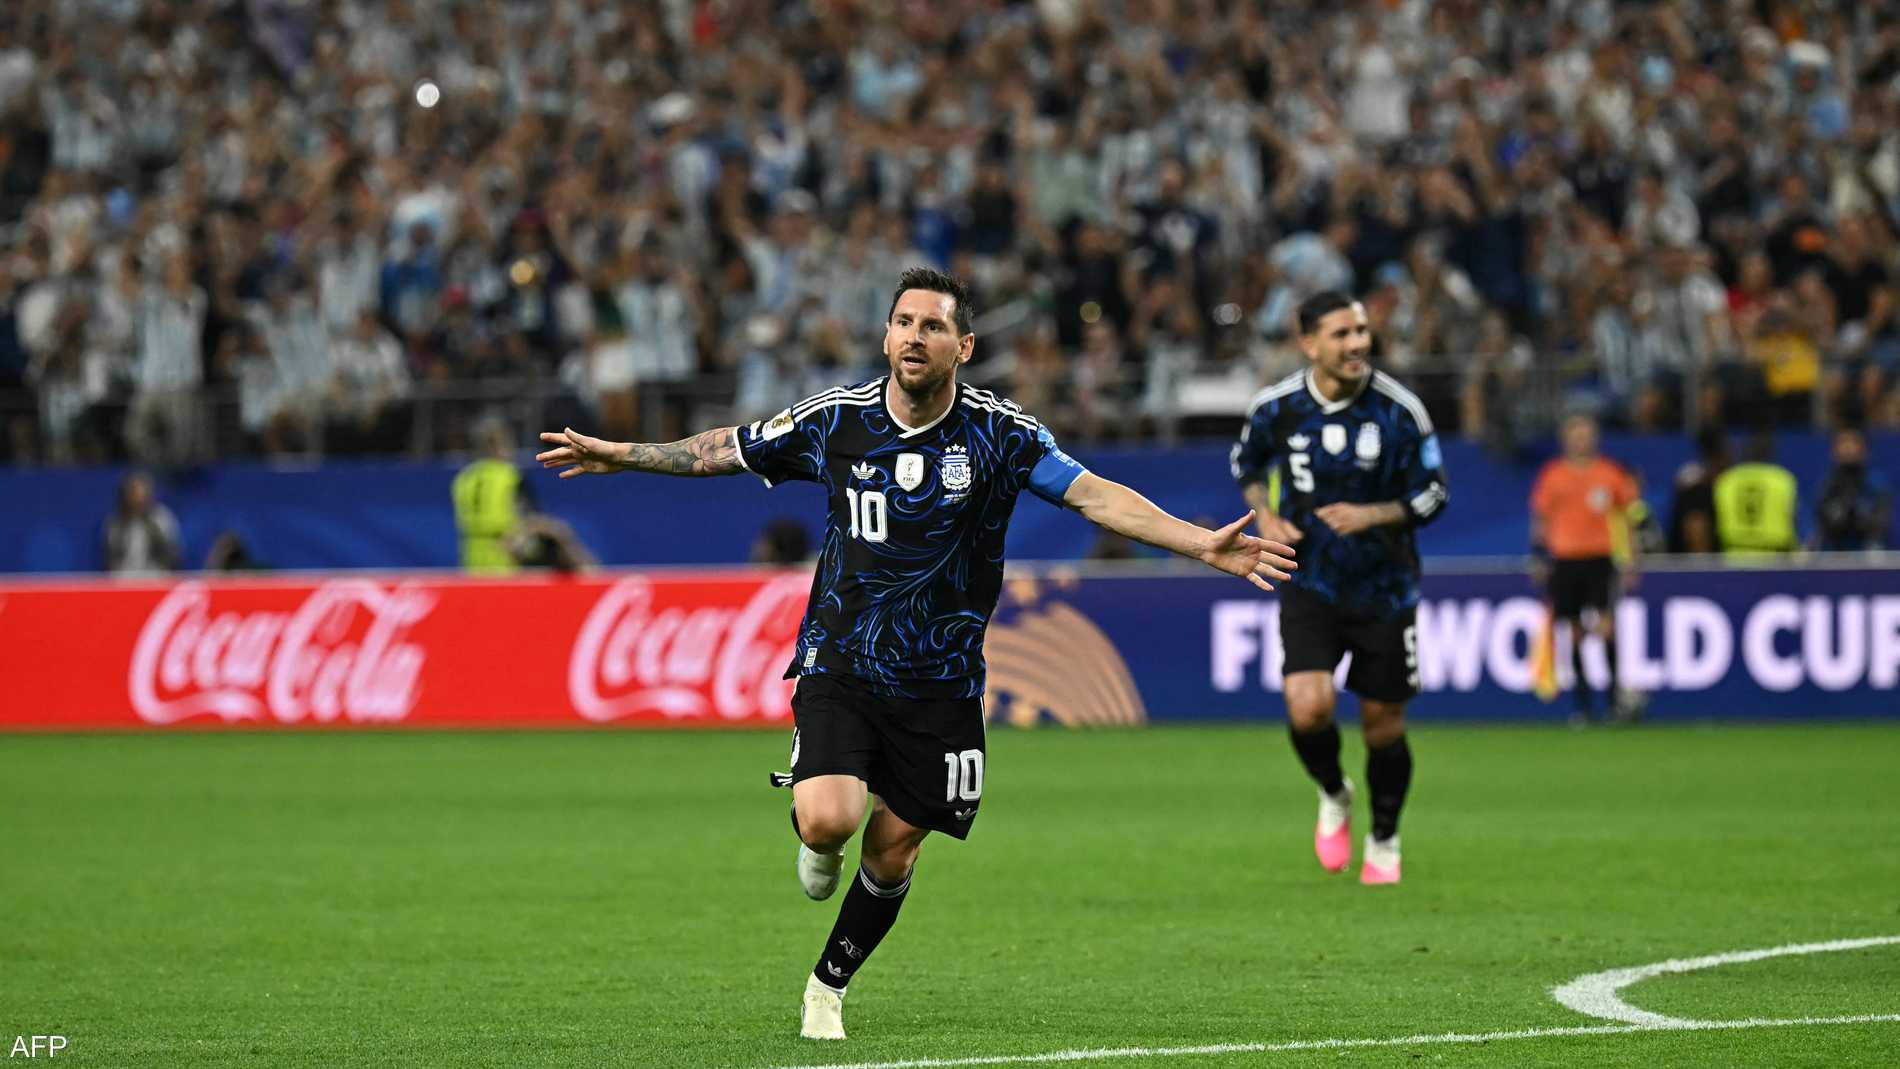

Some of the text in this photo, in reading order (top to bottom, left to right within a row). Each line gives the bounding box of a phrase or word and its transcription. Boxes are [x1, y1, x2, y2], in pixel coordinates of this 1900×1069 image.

[1289, 452, 1315, 492] 5
[846, 488, 887, 543] 10
[568, 574, 814, 722] Coca-Co
[945, 749, 984, 802] 10
